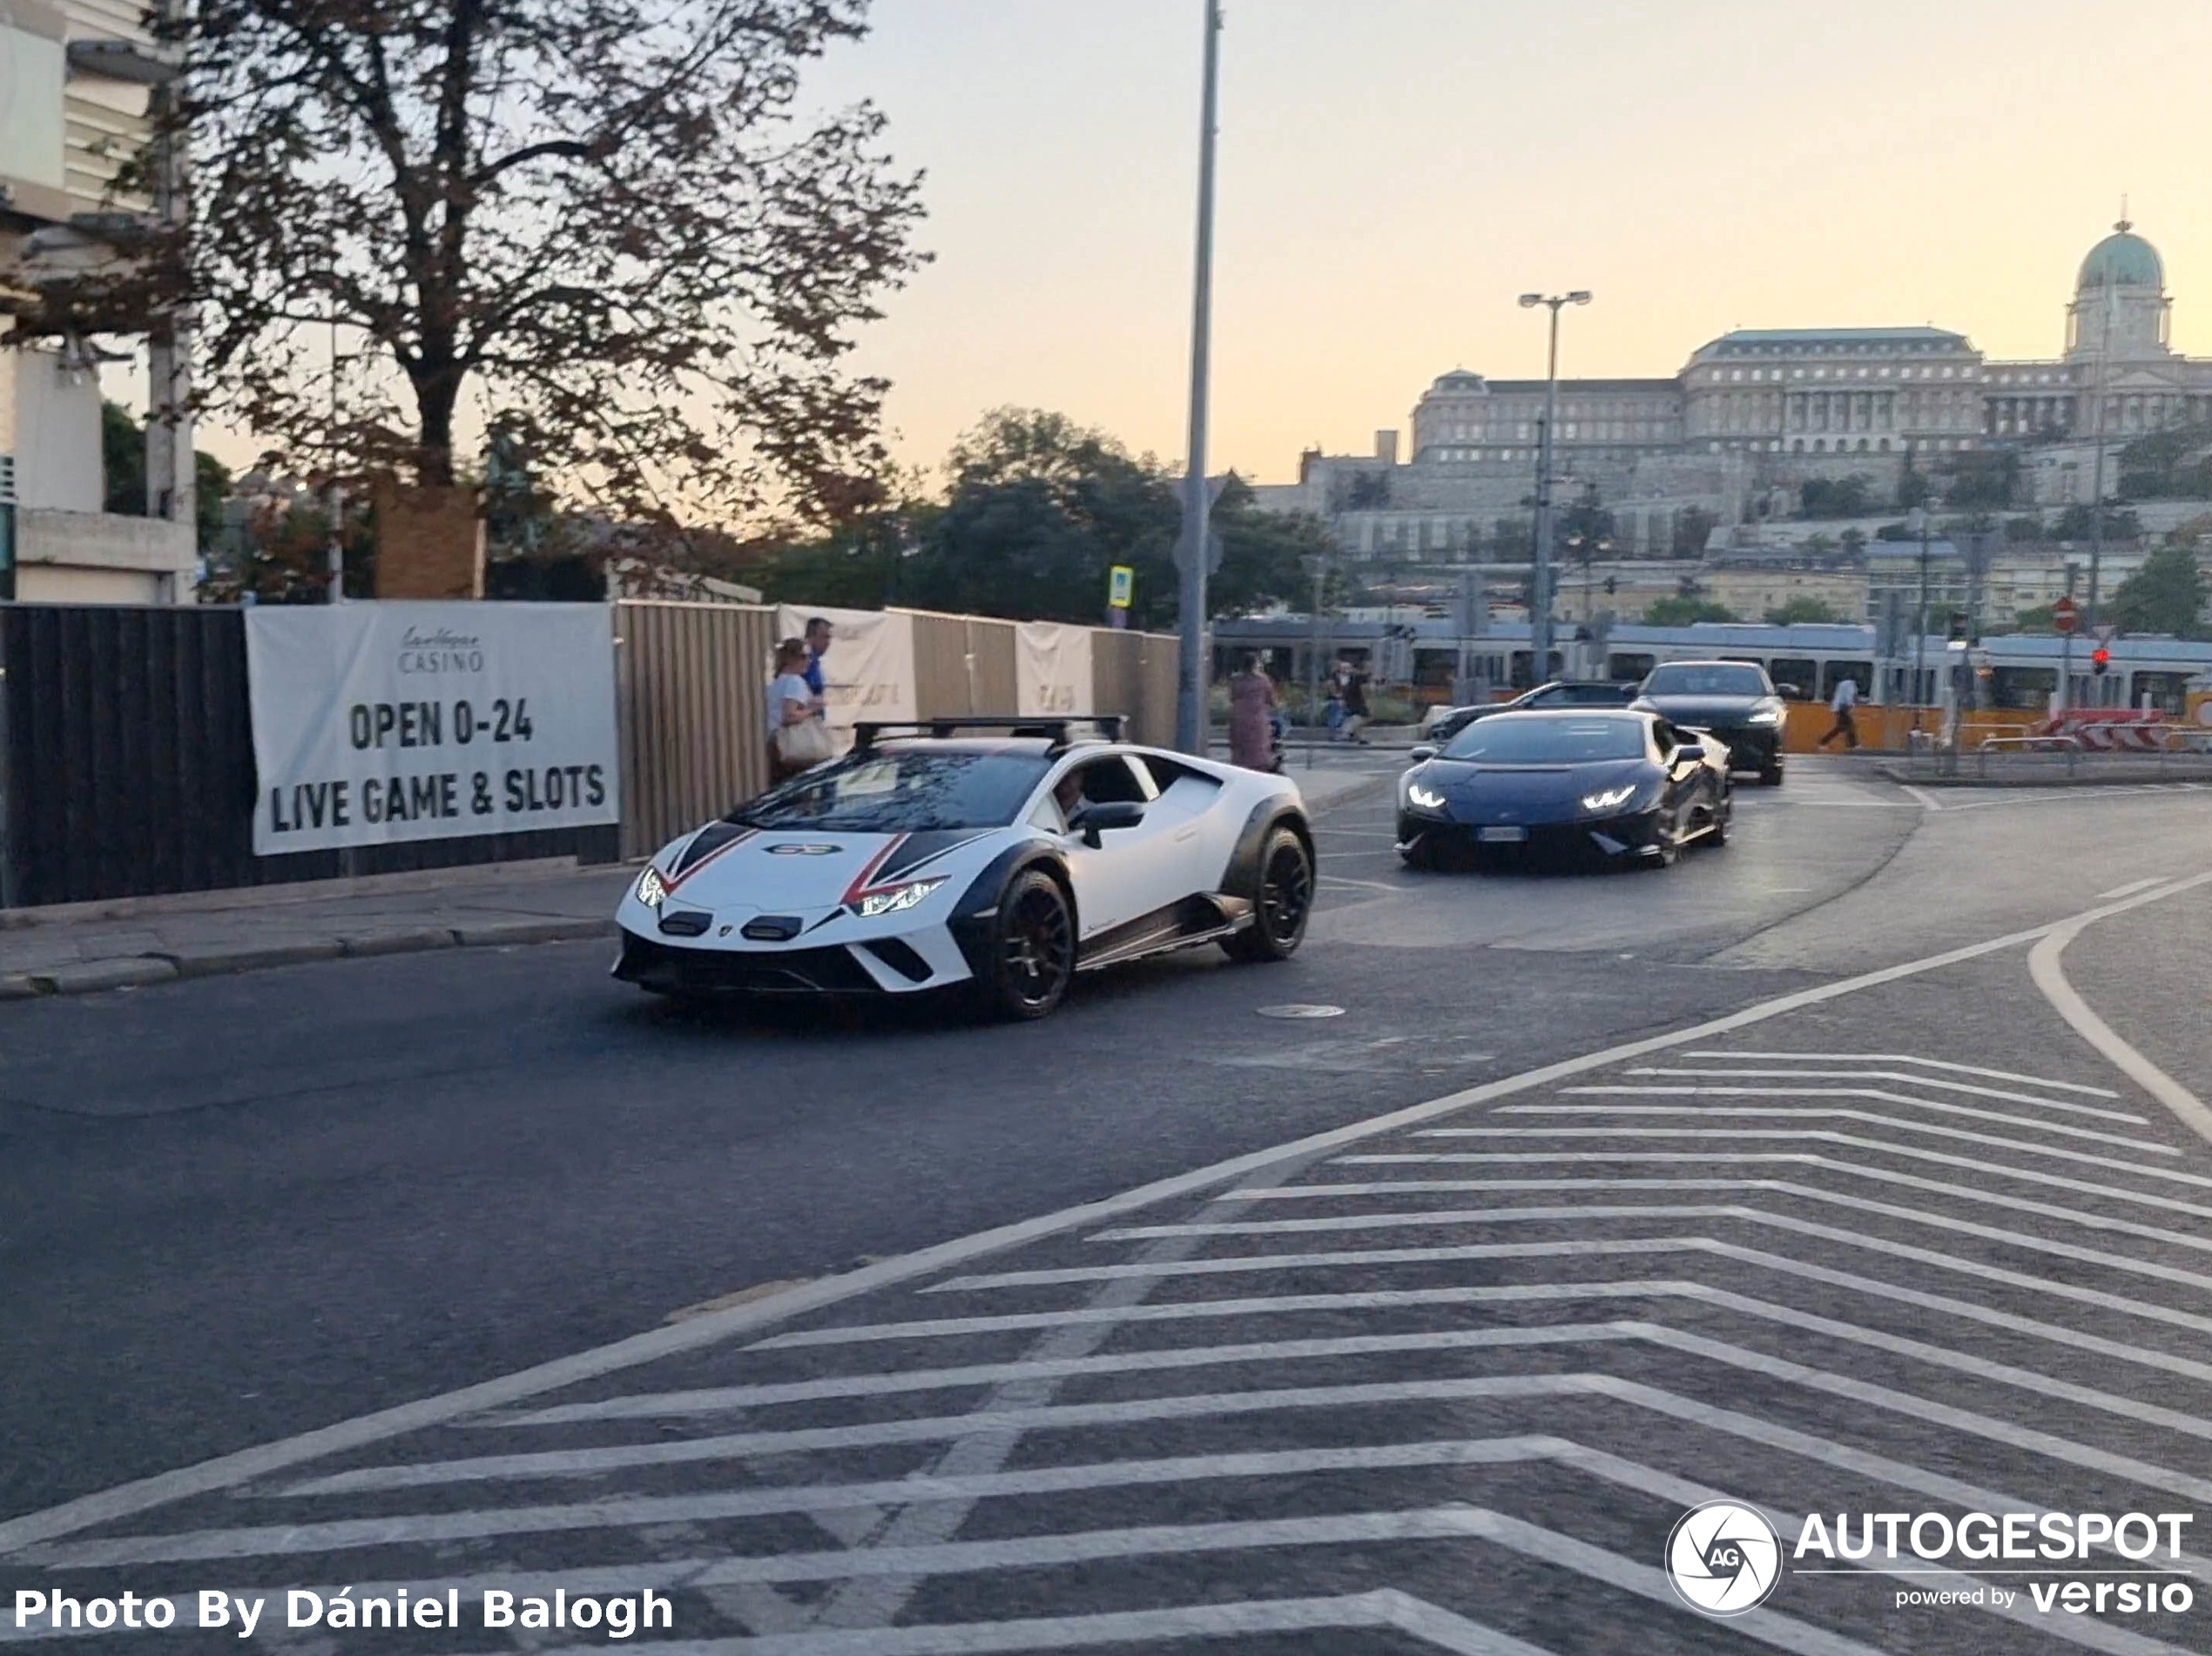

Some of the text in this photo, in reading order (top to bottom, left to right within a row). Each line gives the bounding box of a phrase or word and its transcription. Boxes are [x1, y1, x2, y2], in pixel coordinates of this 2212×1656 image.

[398, 651, 484, 674] CASINO
[351, 698, 533, 750] OPEN 0-24
[272, 764, 606, 832] LIVE GAME & SLOTS
